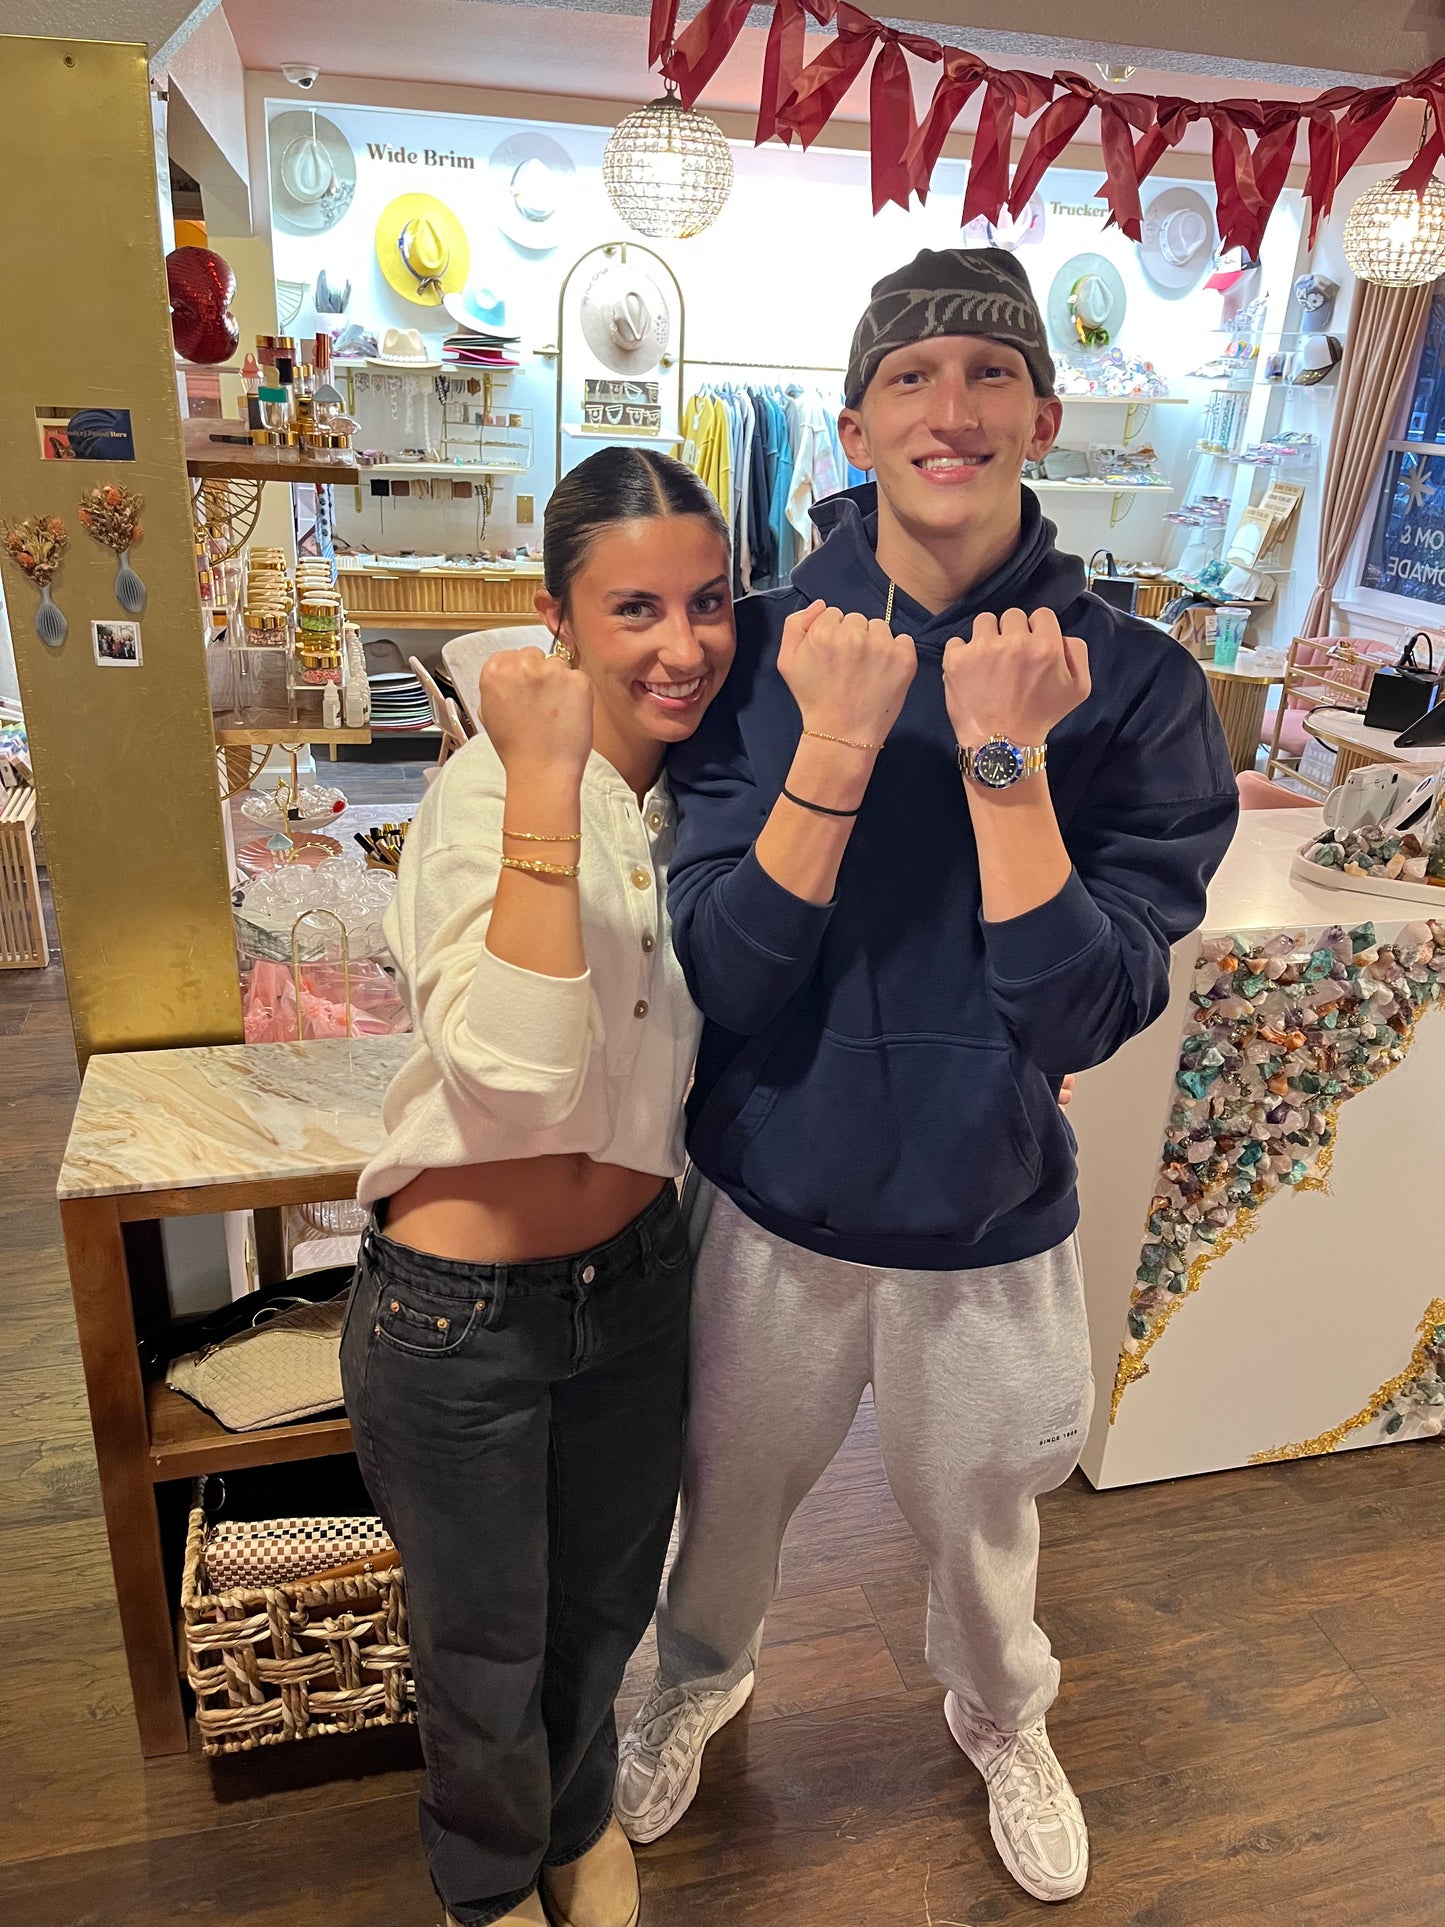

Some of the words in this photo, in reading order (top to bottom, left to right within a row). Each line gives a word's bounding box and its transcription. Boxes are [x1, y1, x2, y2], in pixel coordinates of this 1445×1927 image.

[366, 143, 418, 164] Wide
[424, 149, 475, 169] Brim
[1050, 201, 1108, 217] Trucker
[1040, 1435, 1060, 1445] SINCE
